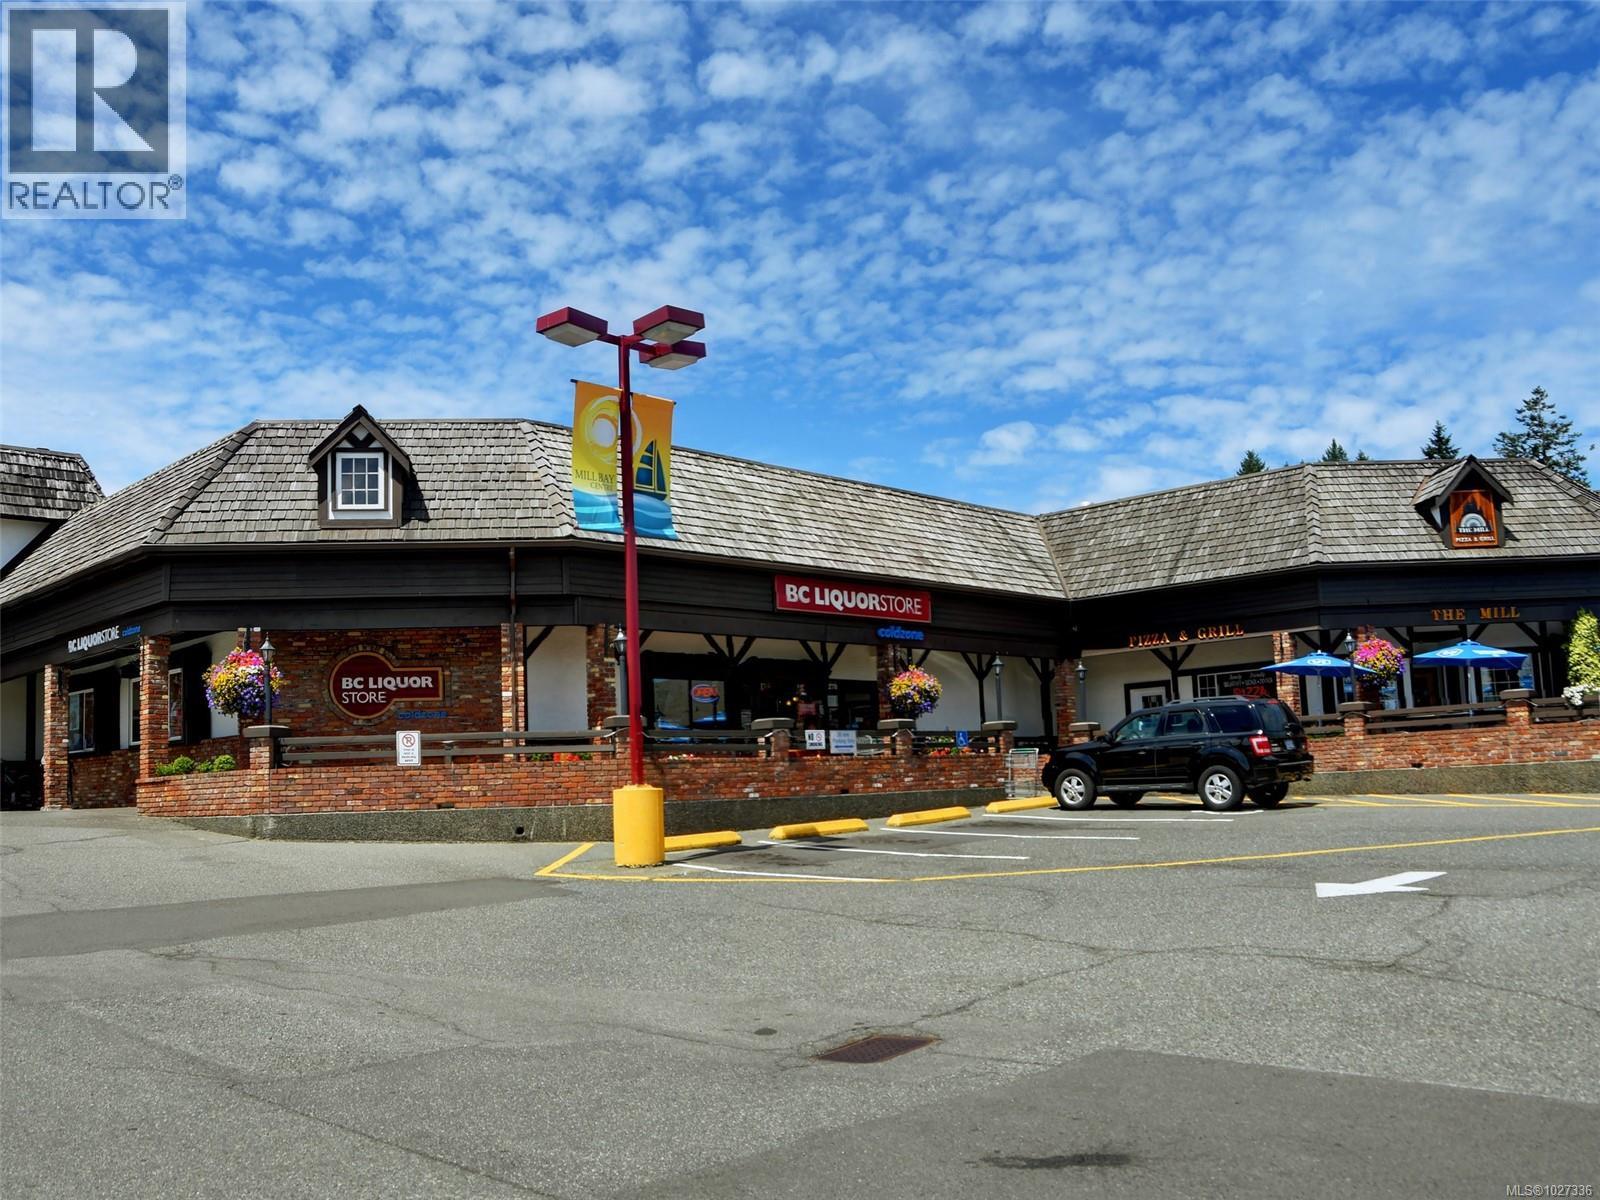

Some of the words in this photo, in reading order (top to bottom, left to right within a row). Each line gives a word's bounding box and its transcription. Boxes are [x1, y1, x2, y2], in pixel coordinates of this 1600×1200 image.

[575, 469, 597, 482] MILL
[598, 473, 615, 484] BAY
[785, 583, 810, 604] BC
[1431, 608, 1466, 621] THE
[1480, 606, 1520, 619] MILL
[877, 626, 924, 640] coldzone
[1129, 632, 1170, 648] PIZZA
[1179, 630, 1188, 641] &
[1197, 623, 1245, 640] GRILL
[68, 639, 77, 653] BC
[341, 677, 364, 689] BC
[368, 676, 433, 691] LIQUOR
[342, 691, 387, 704] STORE
